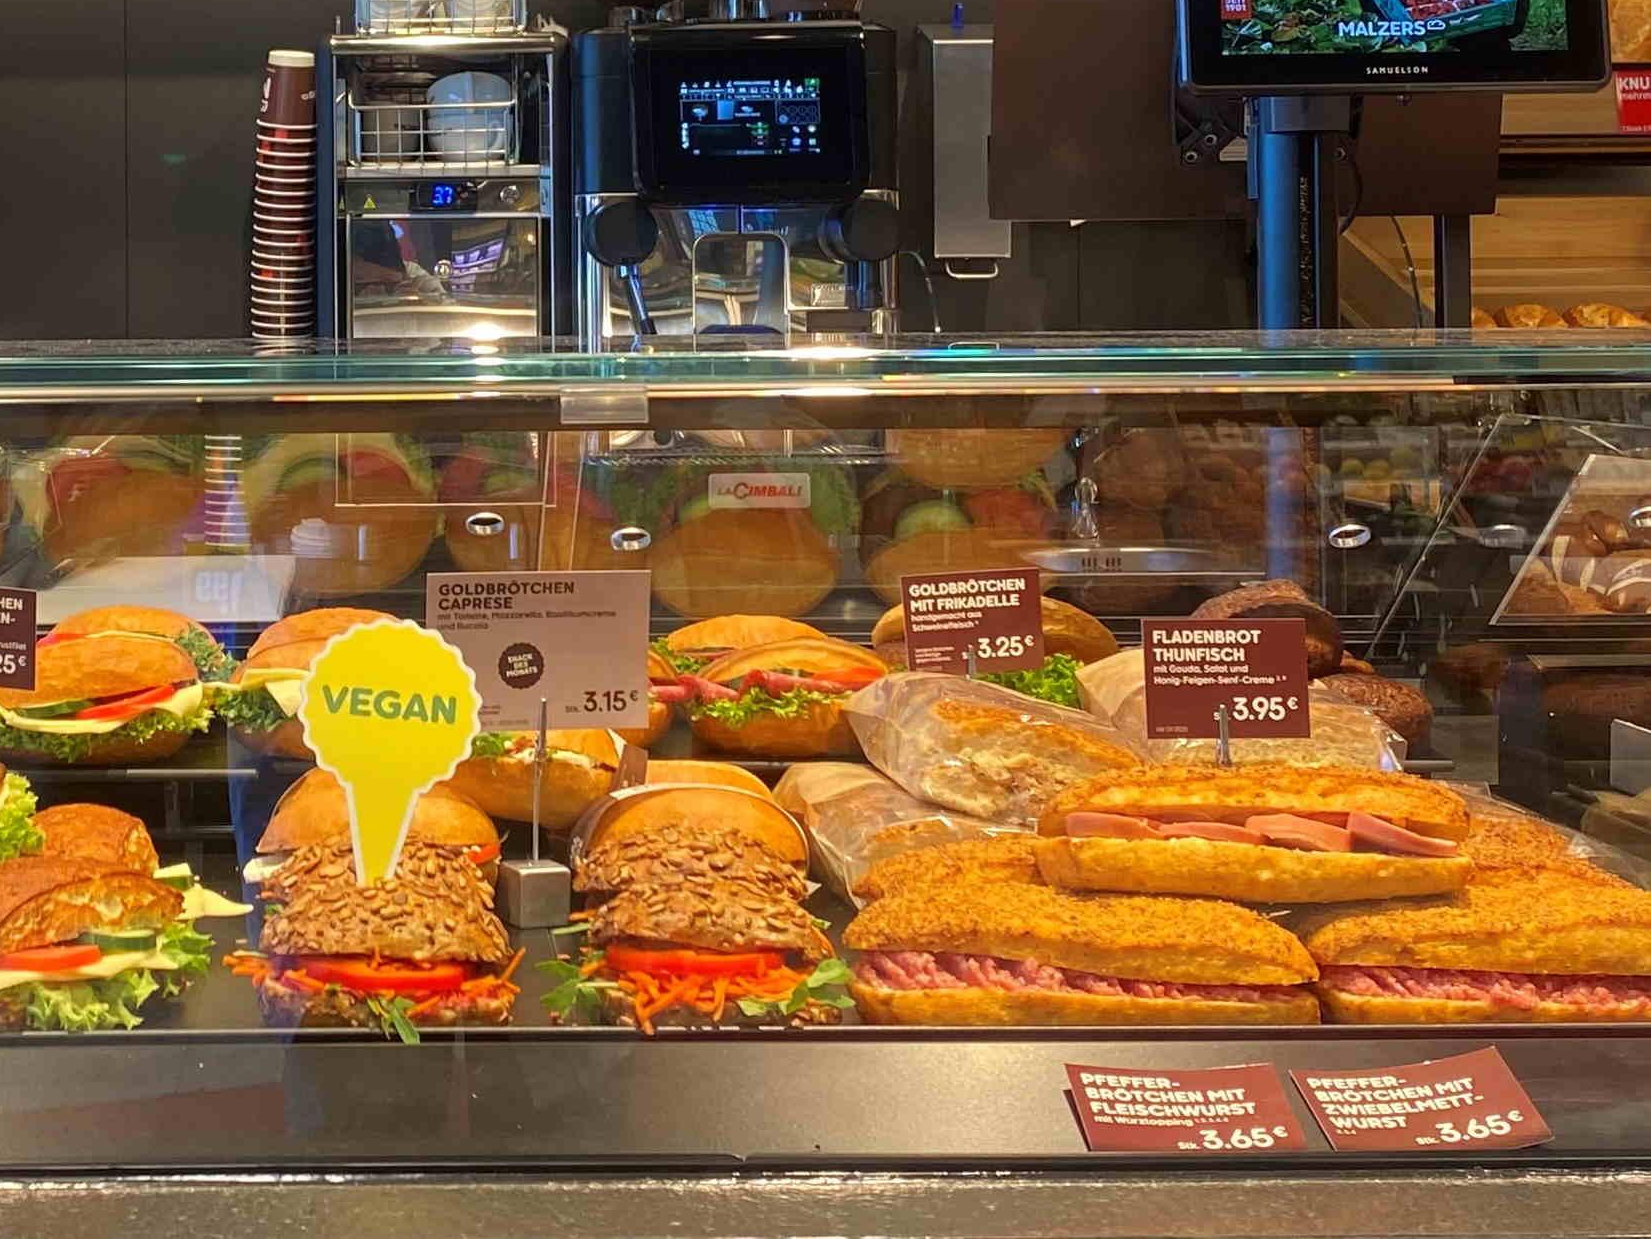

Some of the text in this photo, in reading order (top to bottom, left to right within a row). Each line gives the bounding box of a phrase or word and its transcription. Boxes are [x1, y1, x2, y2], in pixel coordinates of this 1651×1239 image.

[1339, 19, 1427, 37] MALZERS
[1366, 65, 1429, 75] SAMUELSON
[438, 578, 575, 596] GOLDBRÖTCHEN
[909, 577, 1026, 597] GOLDBRÖTCHEN
[438, 596, 513, 610] CAPRESE
[911, 594, 1020, 613] MIT FRIKADELLE
[1152, 629, 1262, 644] FLADENBROT
[1153, 647, 1246, 662] THUNFISCH
[1153, 665, 1168, 674] mit
[1204, 665, 1228, 673] Salat
[1229, 665, 1249, 673] und
[322, 684, 458, 725] VEGAN
[1080, 1072, 1181, 1090] PFEFFER-
[1306, 1074, 1408, 1090] PFEFFER-
[1086, 1087, 1246, 1103] BRÖTCHEN MIT
[1314, 1076, 1474, 1104] BRÖTCHEN MIT
[1090, 1101, 1256, 1117] FLEISCHWURST
[1321, 1092, 1485, 1116] ZWIEBELMETT-
[1094, 1116, 1114, 1124] mit
[1328, 1115, 1408, 1131] WURST
